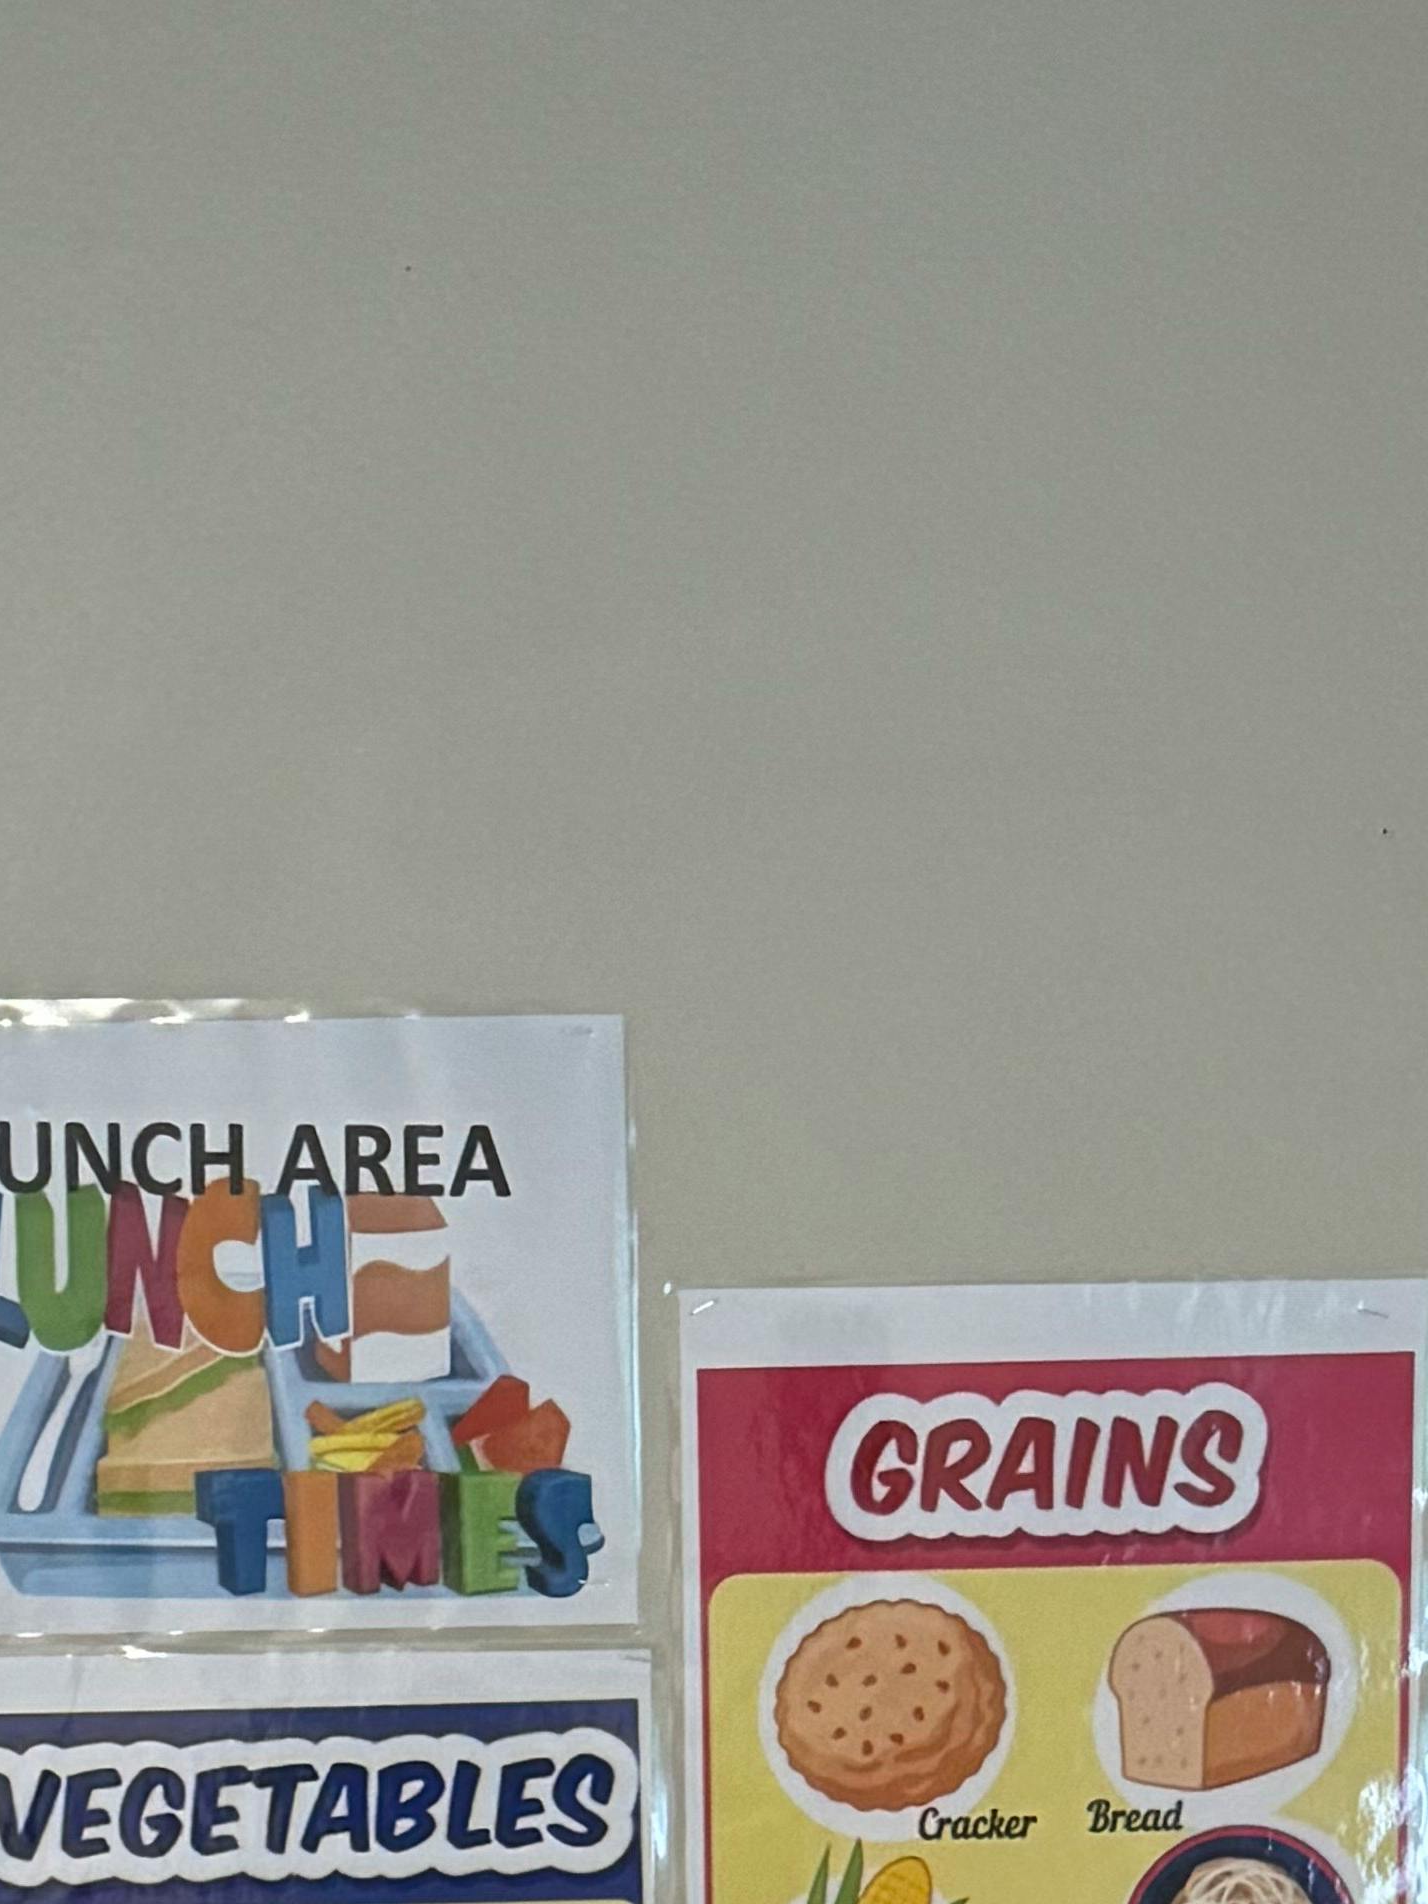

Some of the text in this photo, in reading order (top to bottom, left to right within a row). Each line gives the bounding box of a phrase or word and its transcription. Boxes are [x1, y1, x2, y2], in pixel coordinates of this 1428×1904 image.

[277, 1123, 511, 1198] AREA
[850, 1409, 1244, 1517] GRAINS
[194, 1468, 594, 1598] TIMES
[919, 1806, 1037, 1842] Cracker
[1086, 1799, 1183, 1834] Bread
